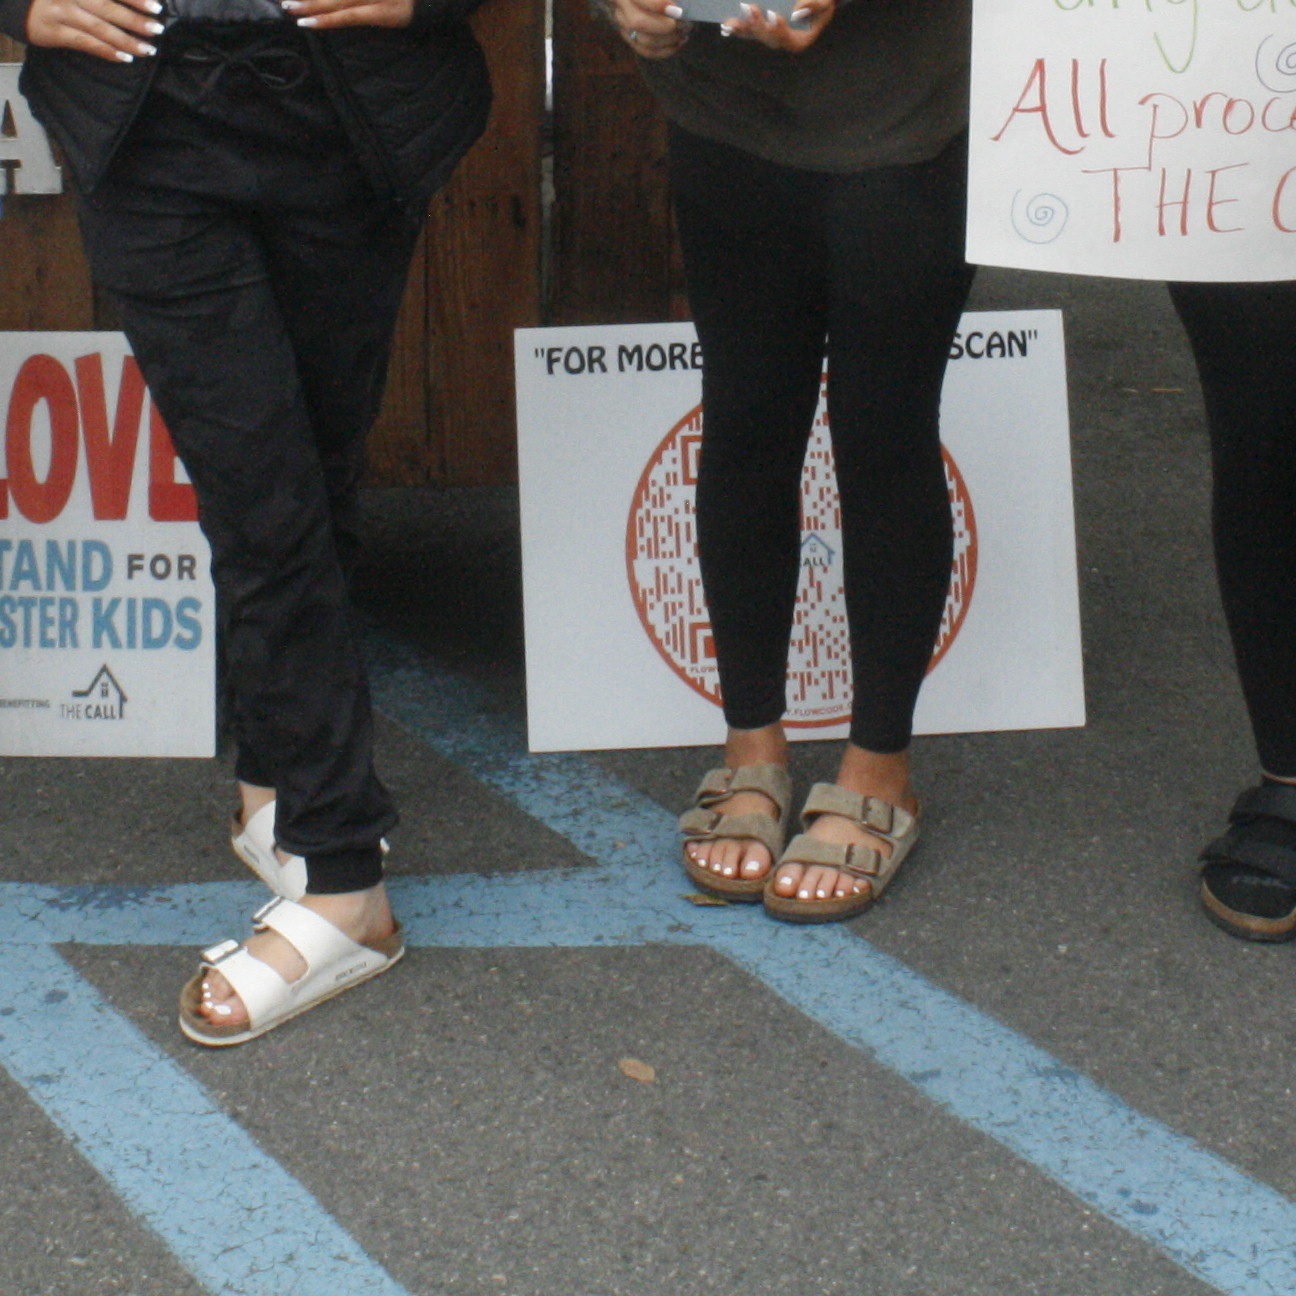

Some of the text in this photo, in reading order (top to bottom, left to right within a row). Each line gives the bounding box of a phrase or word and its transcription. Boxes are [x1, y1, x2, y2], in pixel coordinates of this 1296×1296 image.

[990, 56, 1118, 157] All
[1081, 161, 1251, 244] THE
[126, 553, 198, 582] FOR
[91, 596, 204, 652] KIDS
[60, 703, 117, 720] THE CALL
